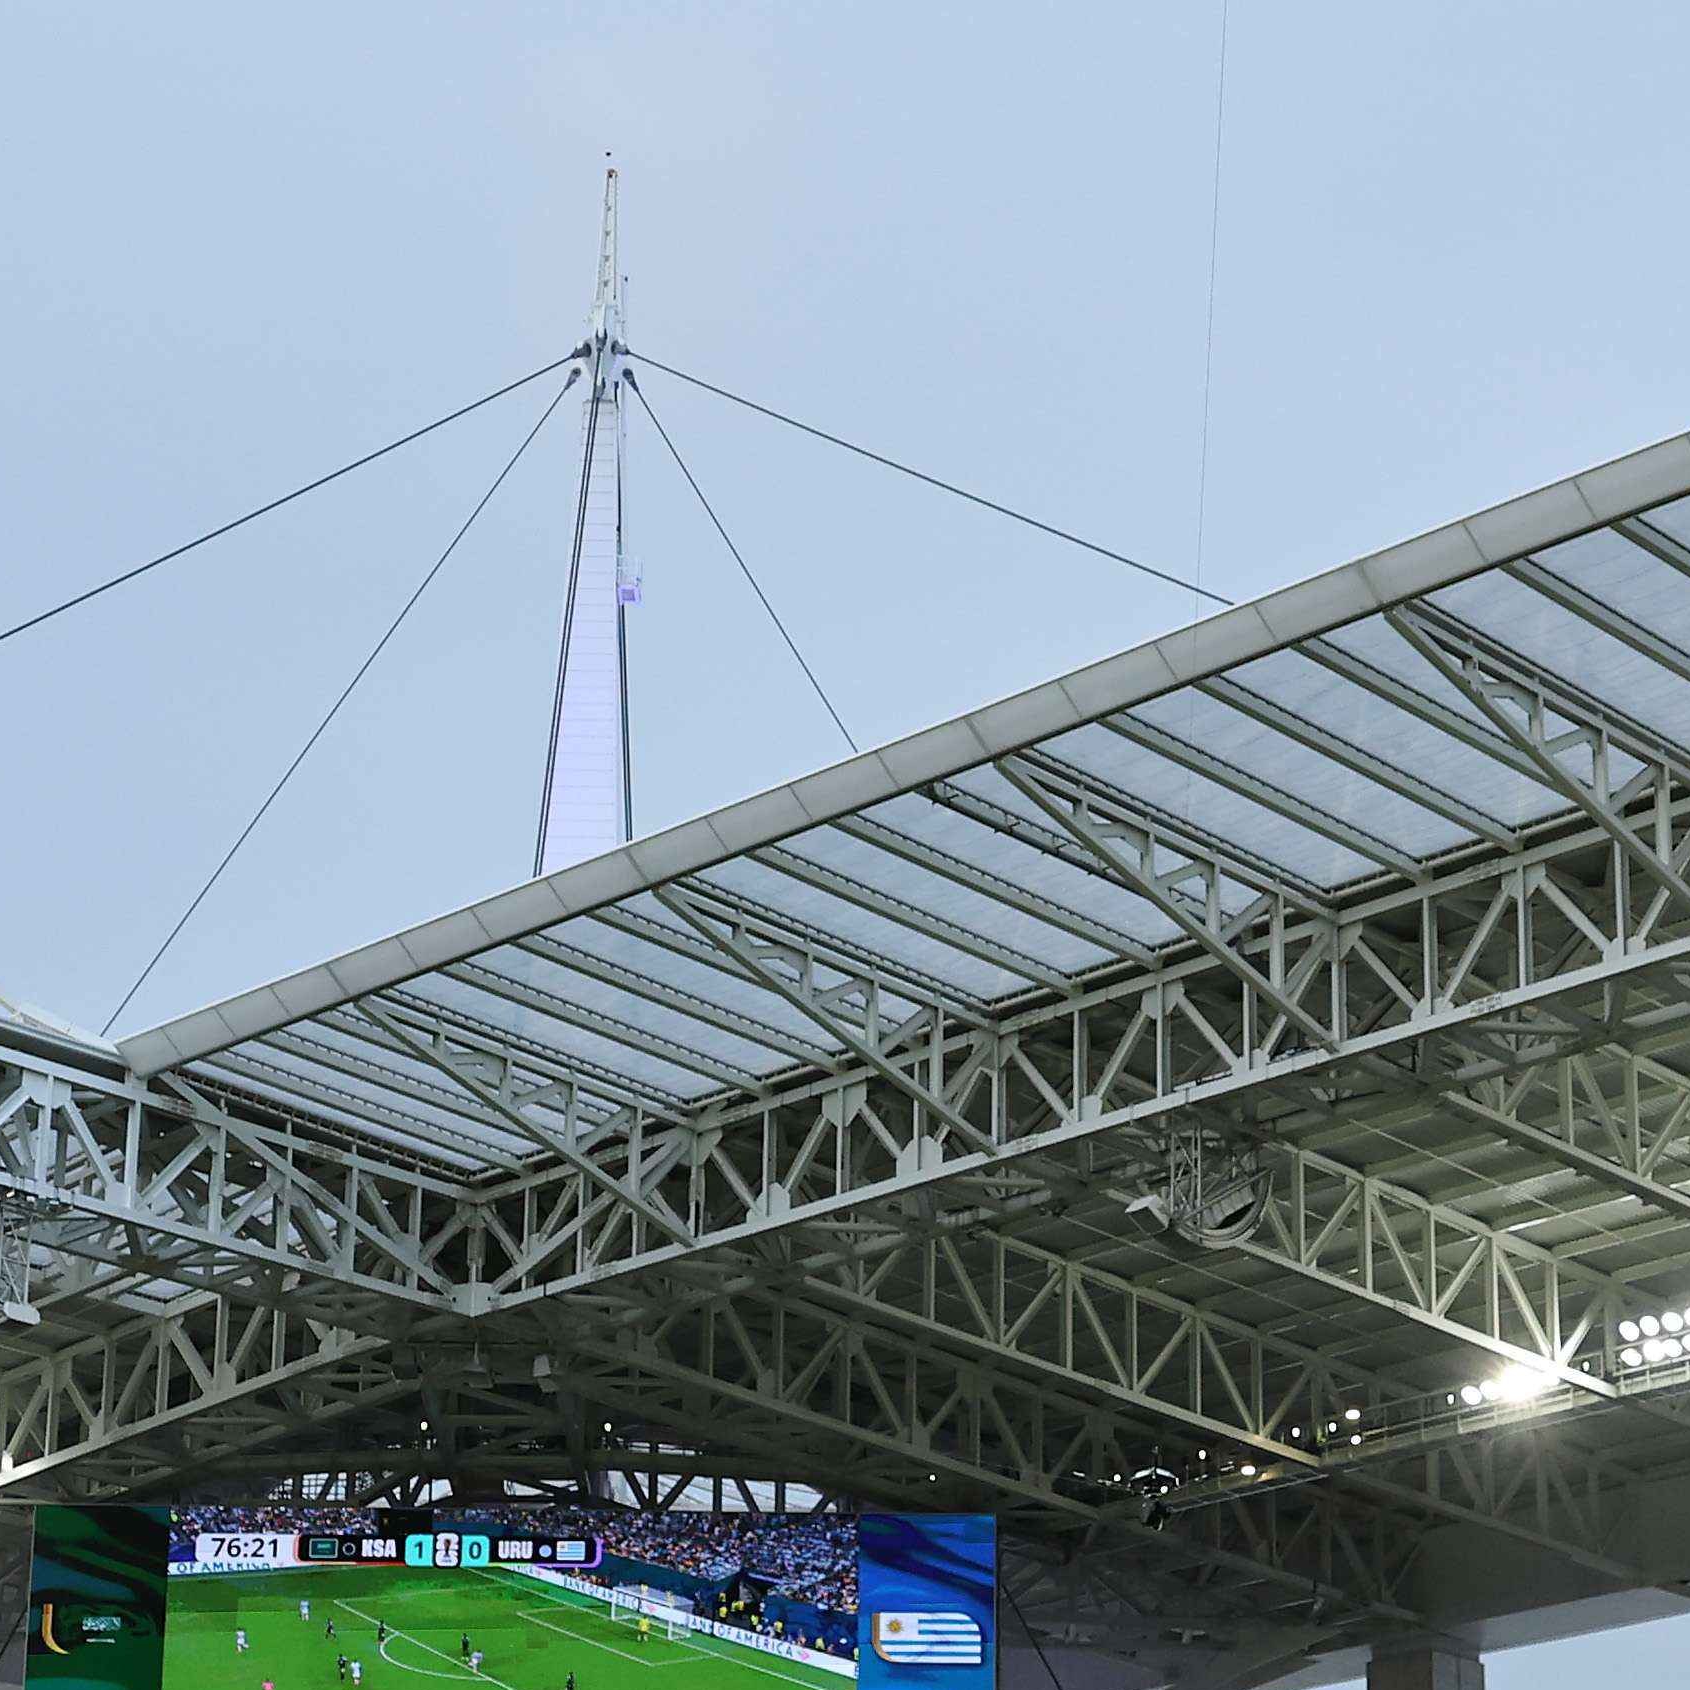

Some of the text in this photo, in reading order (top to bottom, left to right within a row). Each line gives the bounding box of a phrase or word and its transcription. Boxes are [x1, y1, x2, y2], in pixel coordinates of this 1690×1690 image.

[211, 1537, 533, 1560] 76:21 KSA 1 0 URU
